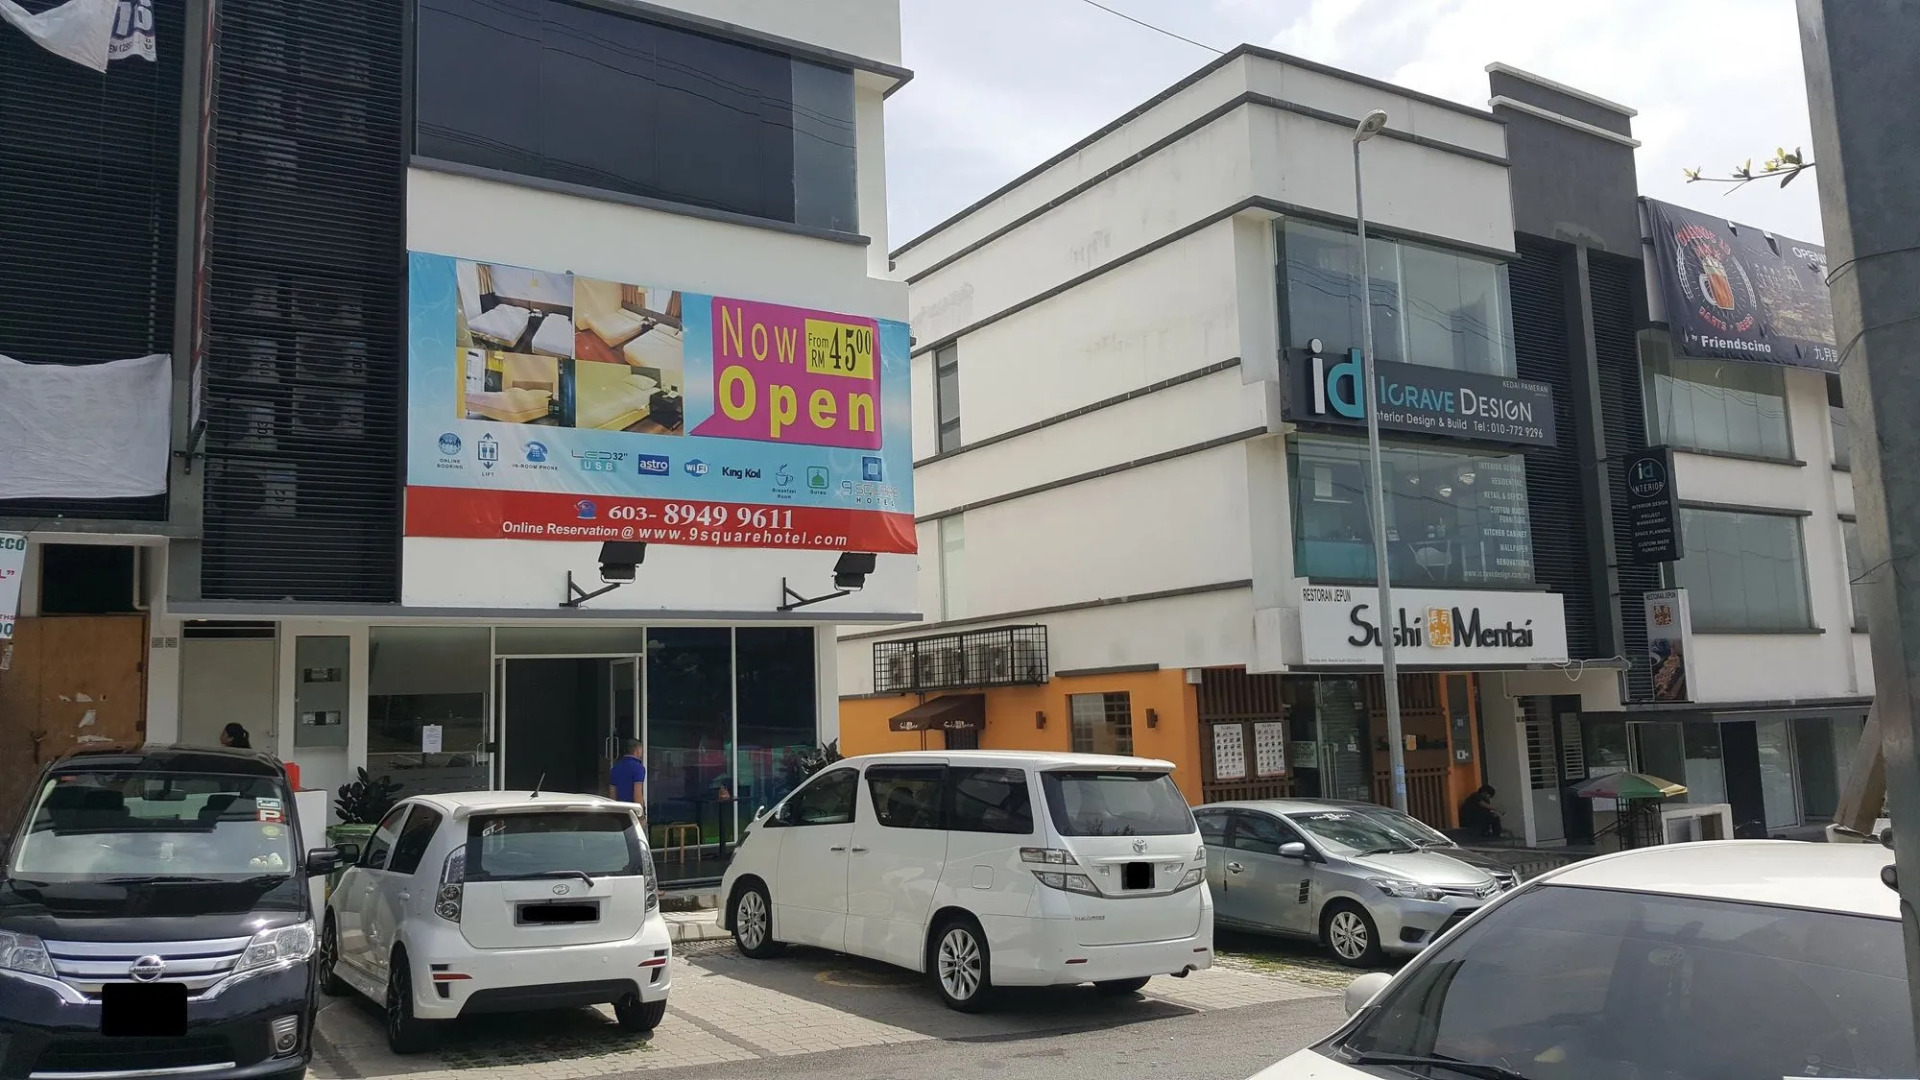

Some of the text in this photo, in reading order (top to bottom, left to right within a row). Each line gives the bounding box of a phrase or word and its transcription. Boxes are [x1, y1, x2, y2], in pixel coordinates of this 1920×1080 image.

[1792, 247, 1827, 265] OPENI
[721, 305, 798, 364] Now
[808, 333, 829, 348] From
[1701, 335, 1772, 353] Friendscino
[811, 350, 826, 368] RM
[1502, 381, 1548, 393] KEDAI PAMERAN
[719, 365, 875, 438] Open
[1459, 387, 1533, 423] DESIGN
[1375, 410, 1404, 424] nterior
[1406, 413, 1436, 428] Design
[1438, 417, 1445, 427] &
[1447, 417, 1468, 431] Build
[1524, 425, 1544, 439] 9296
[583, 461, 615, 472] USB
[639, 459, 668, 470] astro
[722, 467, 743, 479] King
[608, 503, 794, 530] 603- 8949 9611
[502, 521, 543, 534] Online
[546, 522, 618, 537] Reservation
[621, 526, 634, 539] @
[1483, 528, 1505, 537] KITCHEN
[1303, 588, 1352, 602] RESTORAN JEPUN
[1452, 606, 1533, 648] Mentai
[260, 810, 280, 821] P
